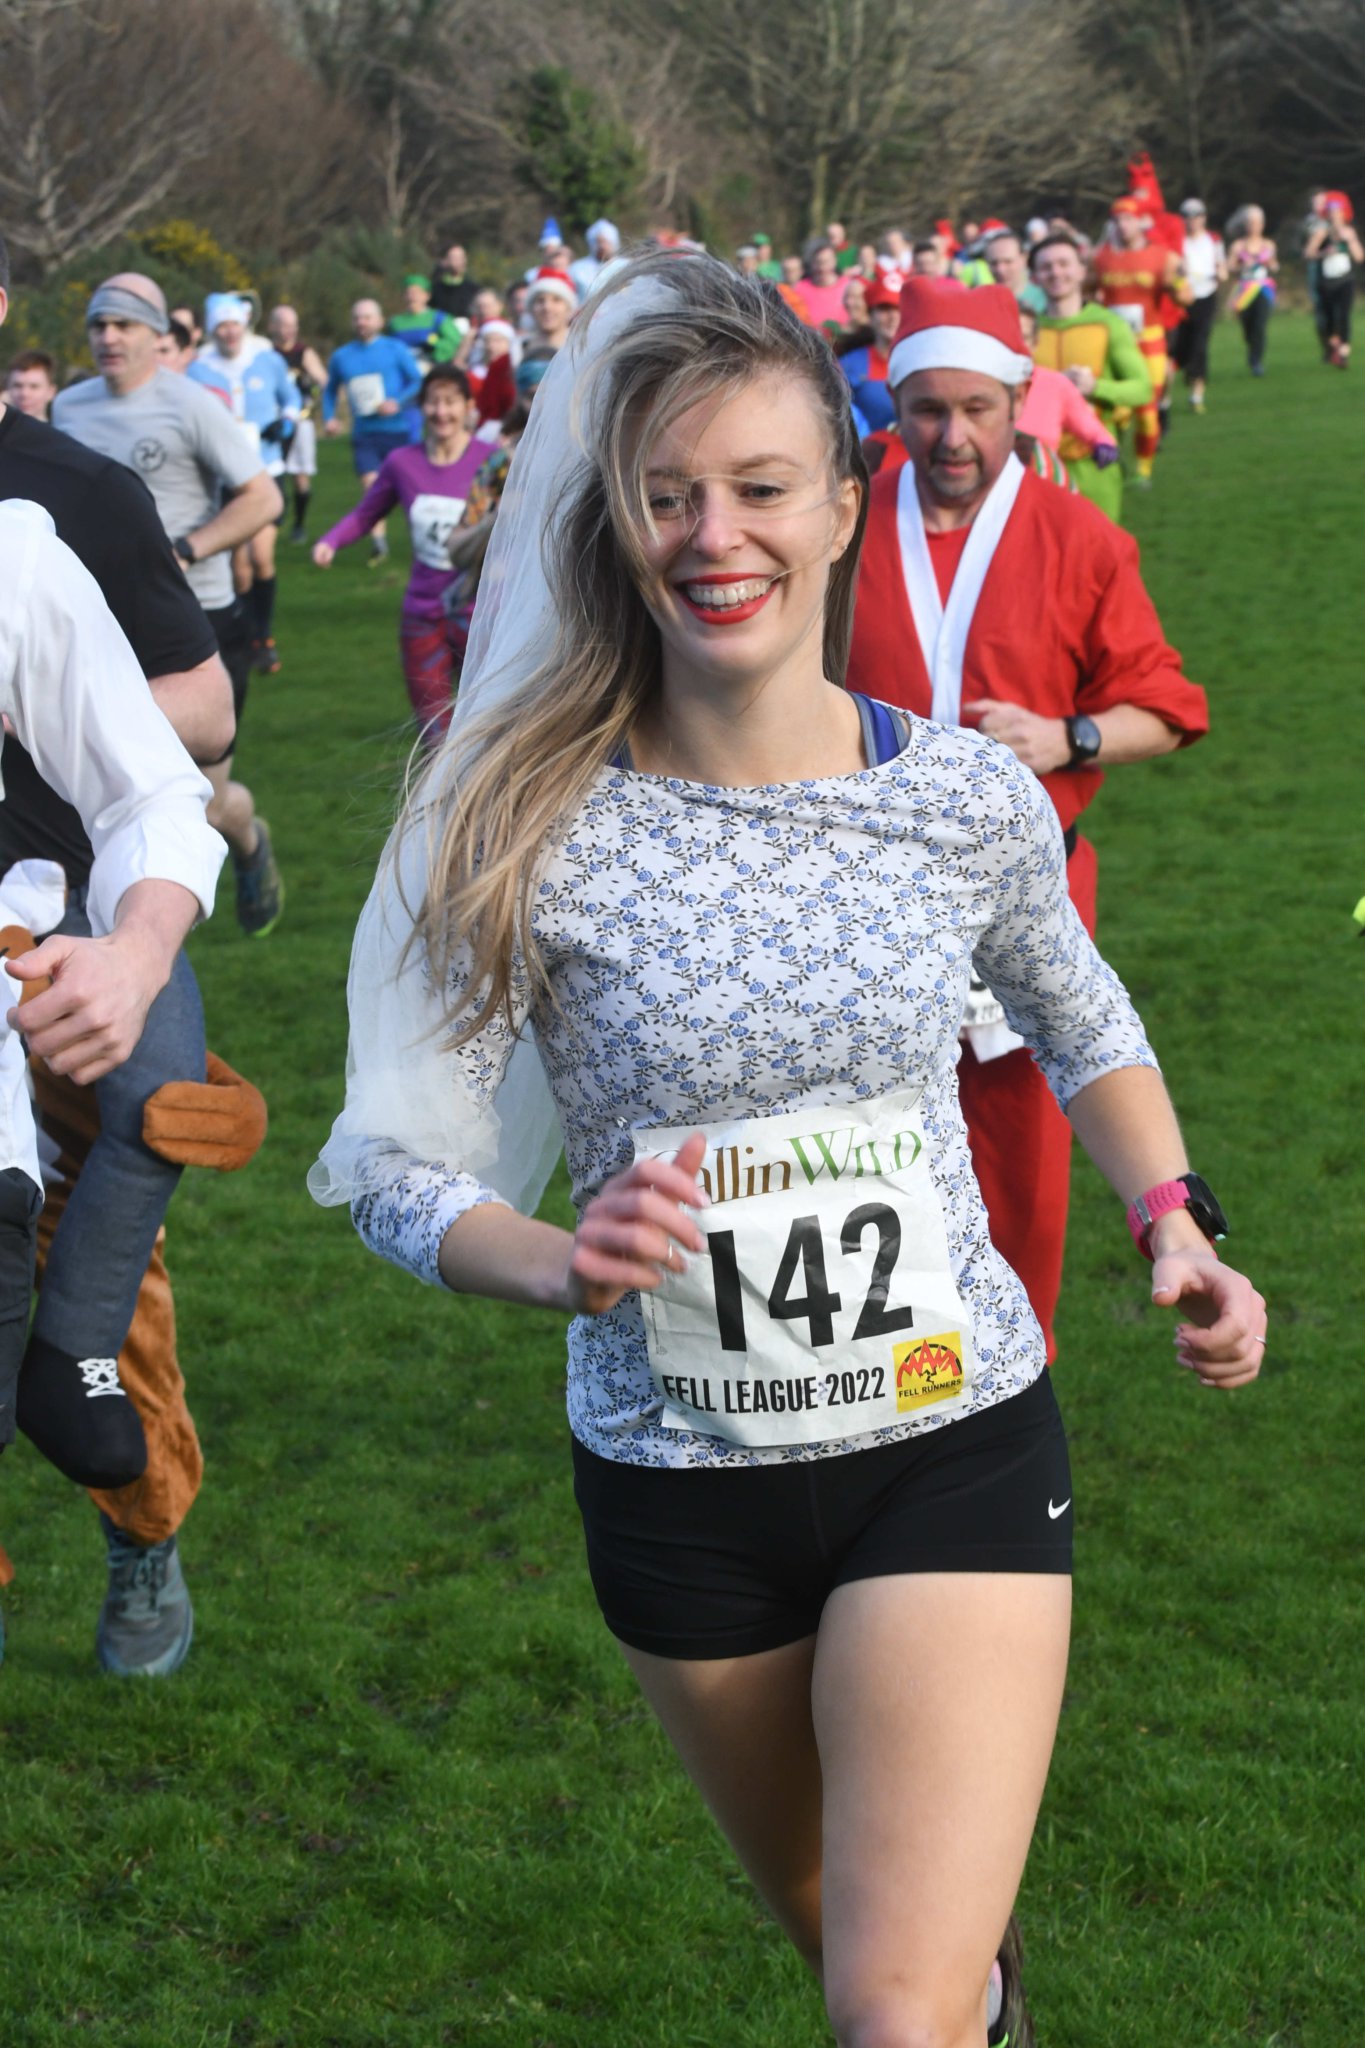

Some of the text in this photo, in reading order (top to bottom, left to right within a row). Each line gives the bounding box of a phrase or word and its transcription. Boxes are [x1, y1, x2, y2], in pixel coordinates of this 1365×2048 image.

[707, 1202, 913, 1352] 142
[662, 1367, 886, 1413] FELL LEAGUE 2022
[899, 1379, 961, 1398] FELL RUNNERS
